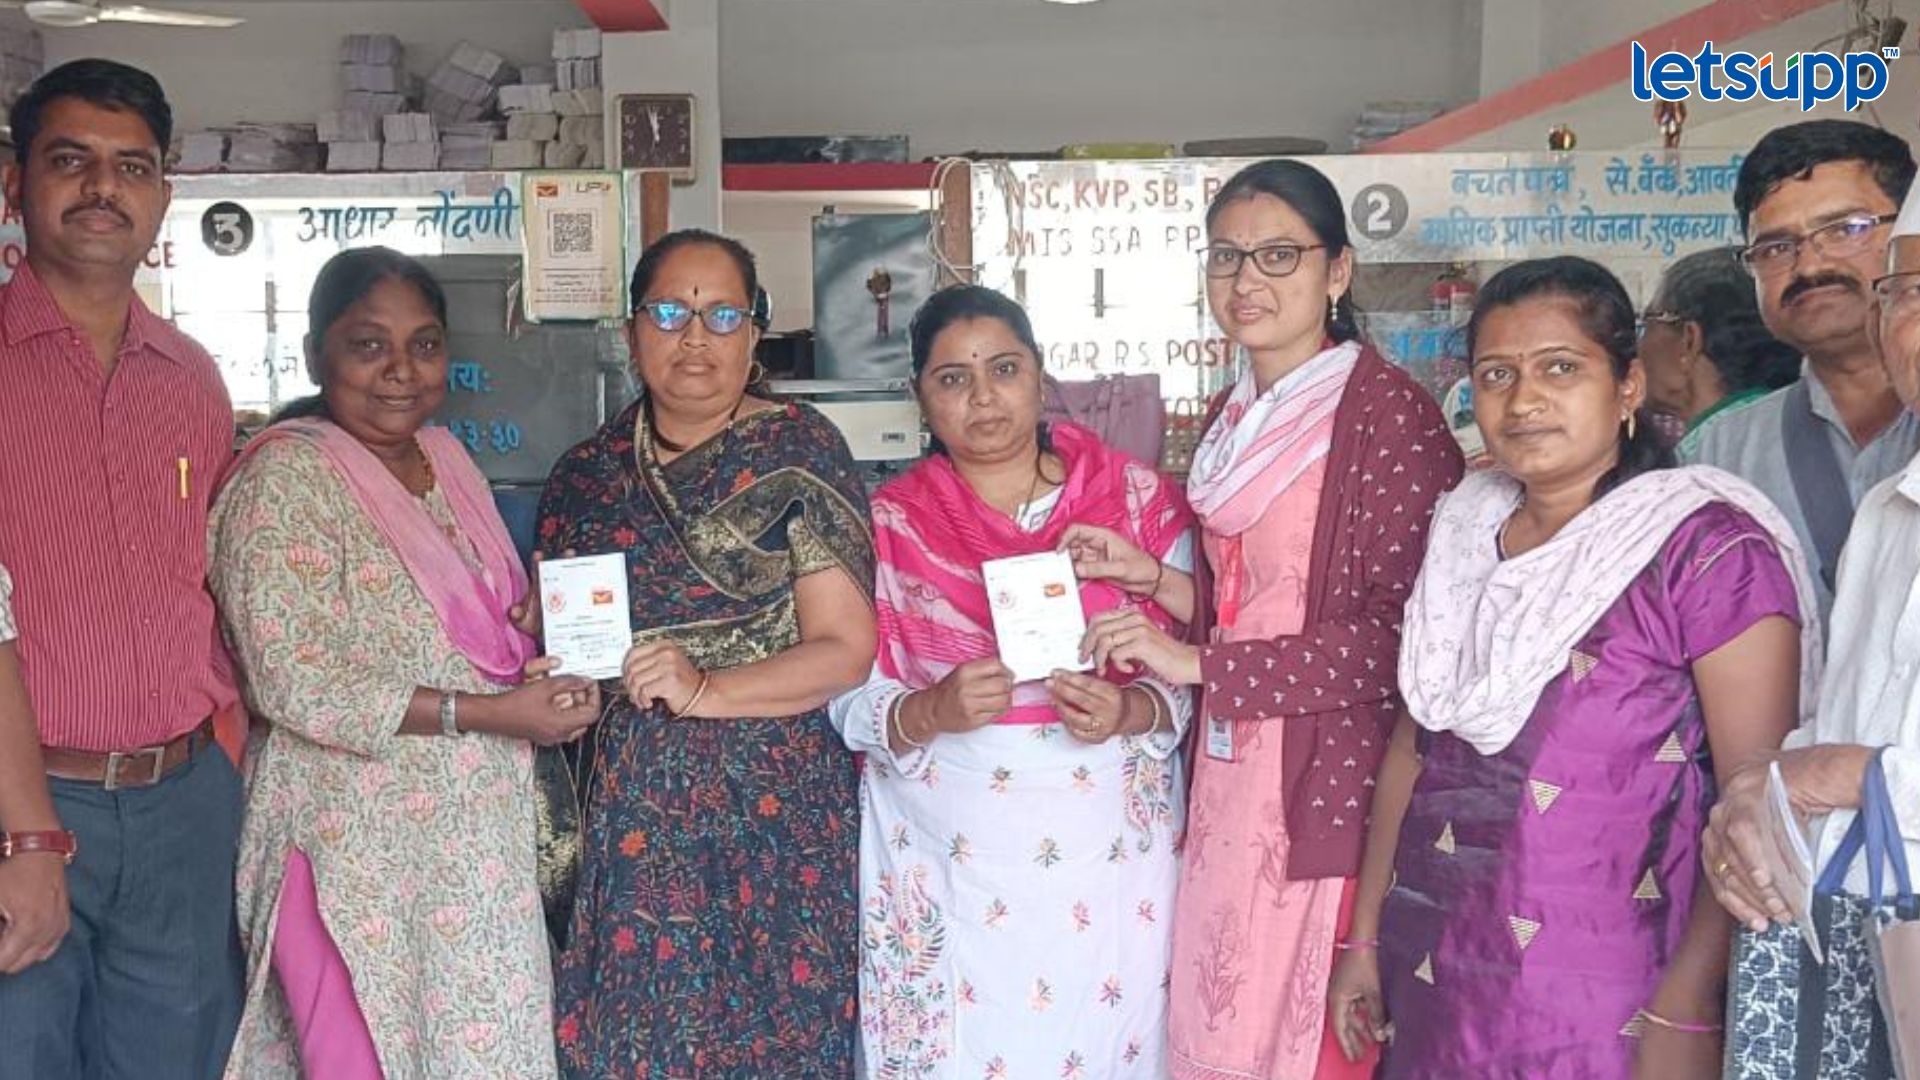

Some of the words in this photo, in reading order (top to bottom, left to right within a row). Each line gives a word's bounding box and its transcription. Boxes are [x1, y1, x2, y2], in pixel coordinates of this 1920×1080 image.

[211, 212, 243, 250] 3
[298, 205, 397, 241] आधार
[1367, 199, 1391, 230] 2
[1166, 338, 1234, 367] POST
